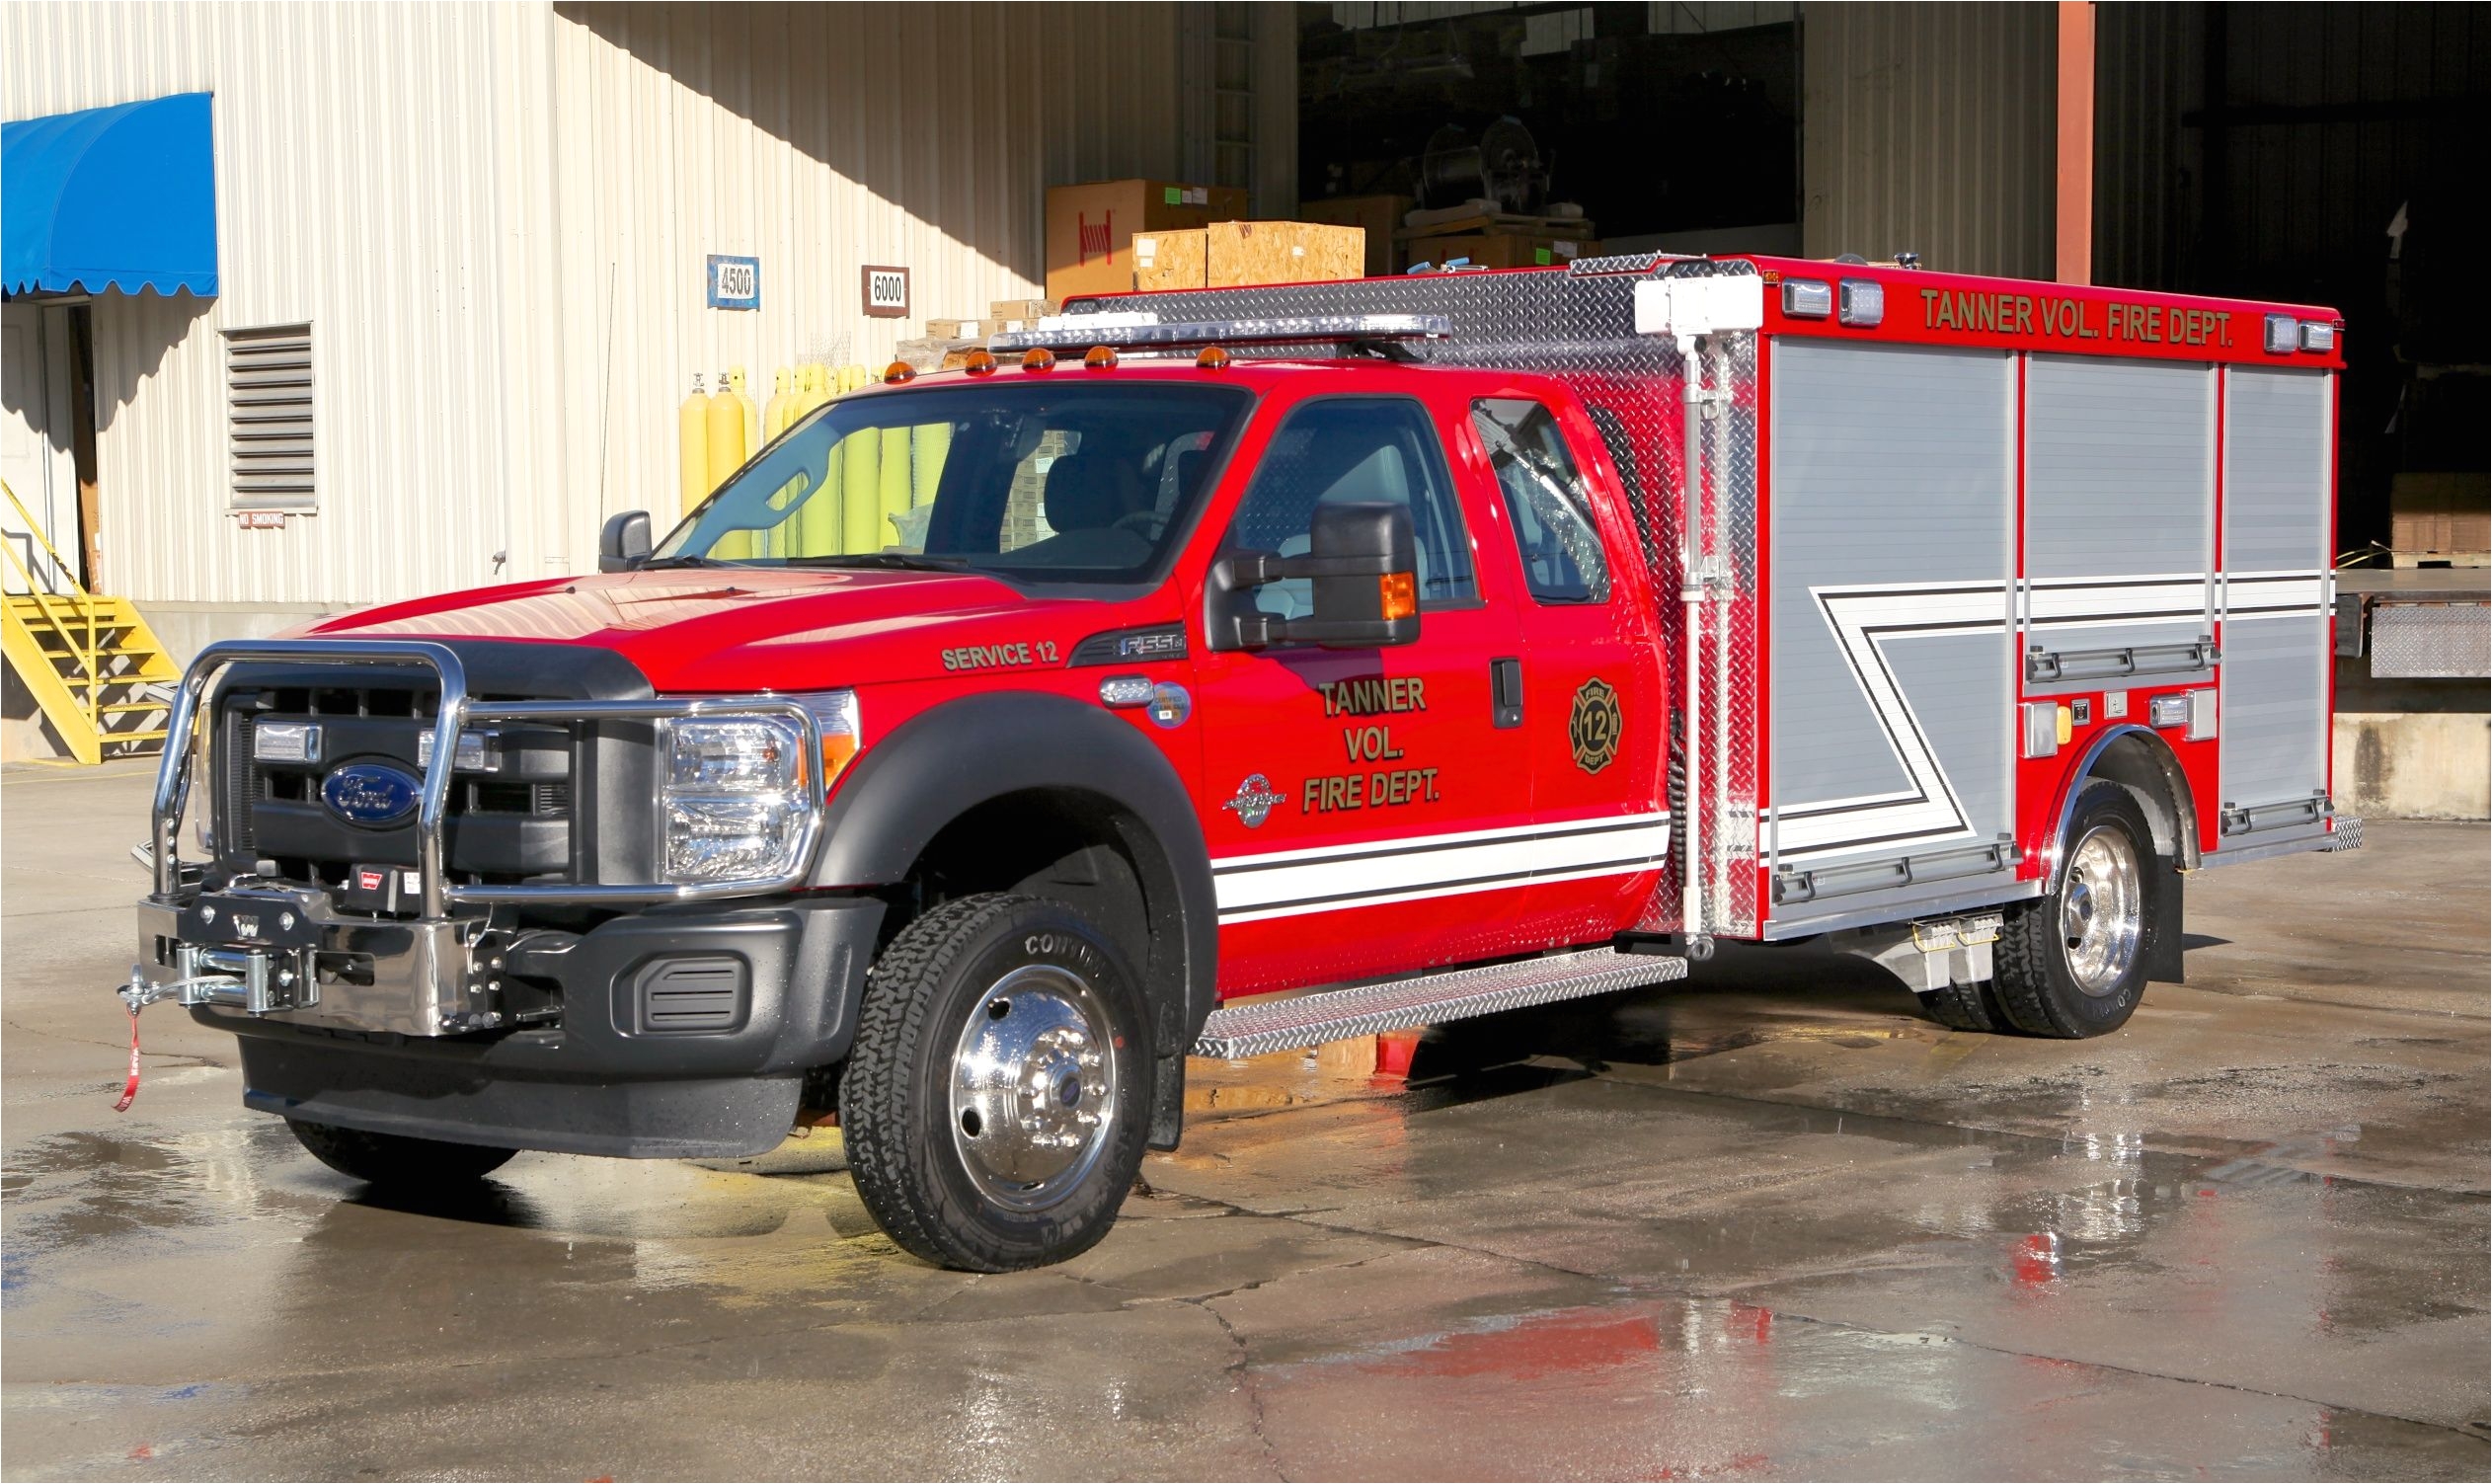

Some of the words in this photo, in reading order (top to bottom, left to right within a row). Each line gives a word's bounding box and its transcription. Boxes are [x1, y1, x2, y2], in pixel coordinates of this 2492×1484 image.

[721, 267, 751, 295] 4500
[874, 275, 902, 302] 6000
[1920, 288, 2033, 334] TANNER
[2040, 298, 2099, 338] VOL.
[2107, 302, 2161, 342] FIRE
[2168, 307, 2233, 347] DEPT.
[239, 512, 249, 524] NO
[252, 512, 284, 524] SMOKING
[941, 643, 1033, 671] SERVICE
[1036, 641, 1060, 663] 12
[1318, 677, 1427, 717] TANNER
[1586, 686, 1605, 700] FIRE
[1583, 710, 1607, 742] 12
[1344, 725, 1404, 761] VOL.
[1585, 752, 1604, 765] DEPT
[337, 773, 393, 809] Ford
[1302, 774, 1364, 814] FIRE
[1370, 767, 1440, 808] DEPT.
